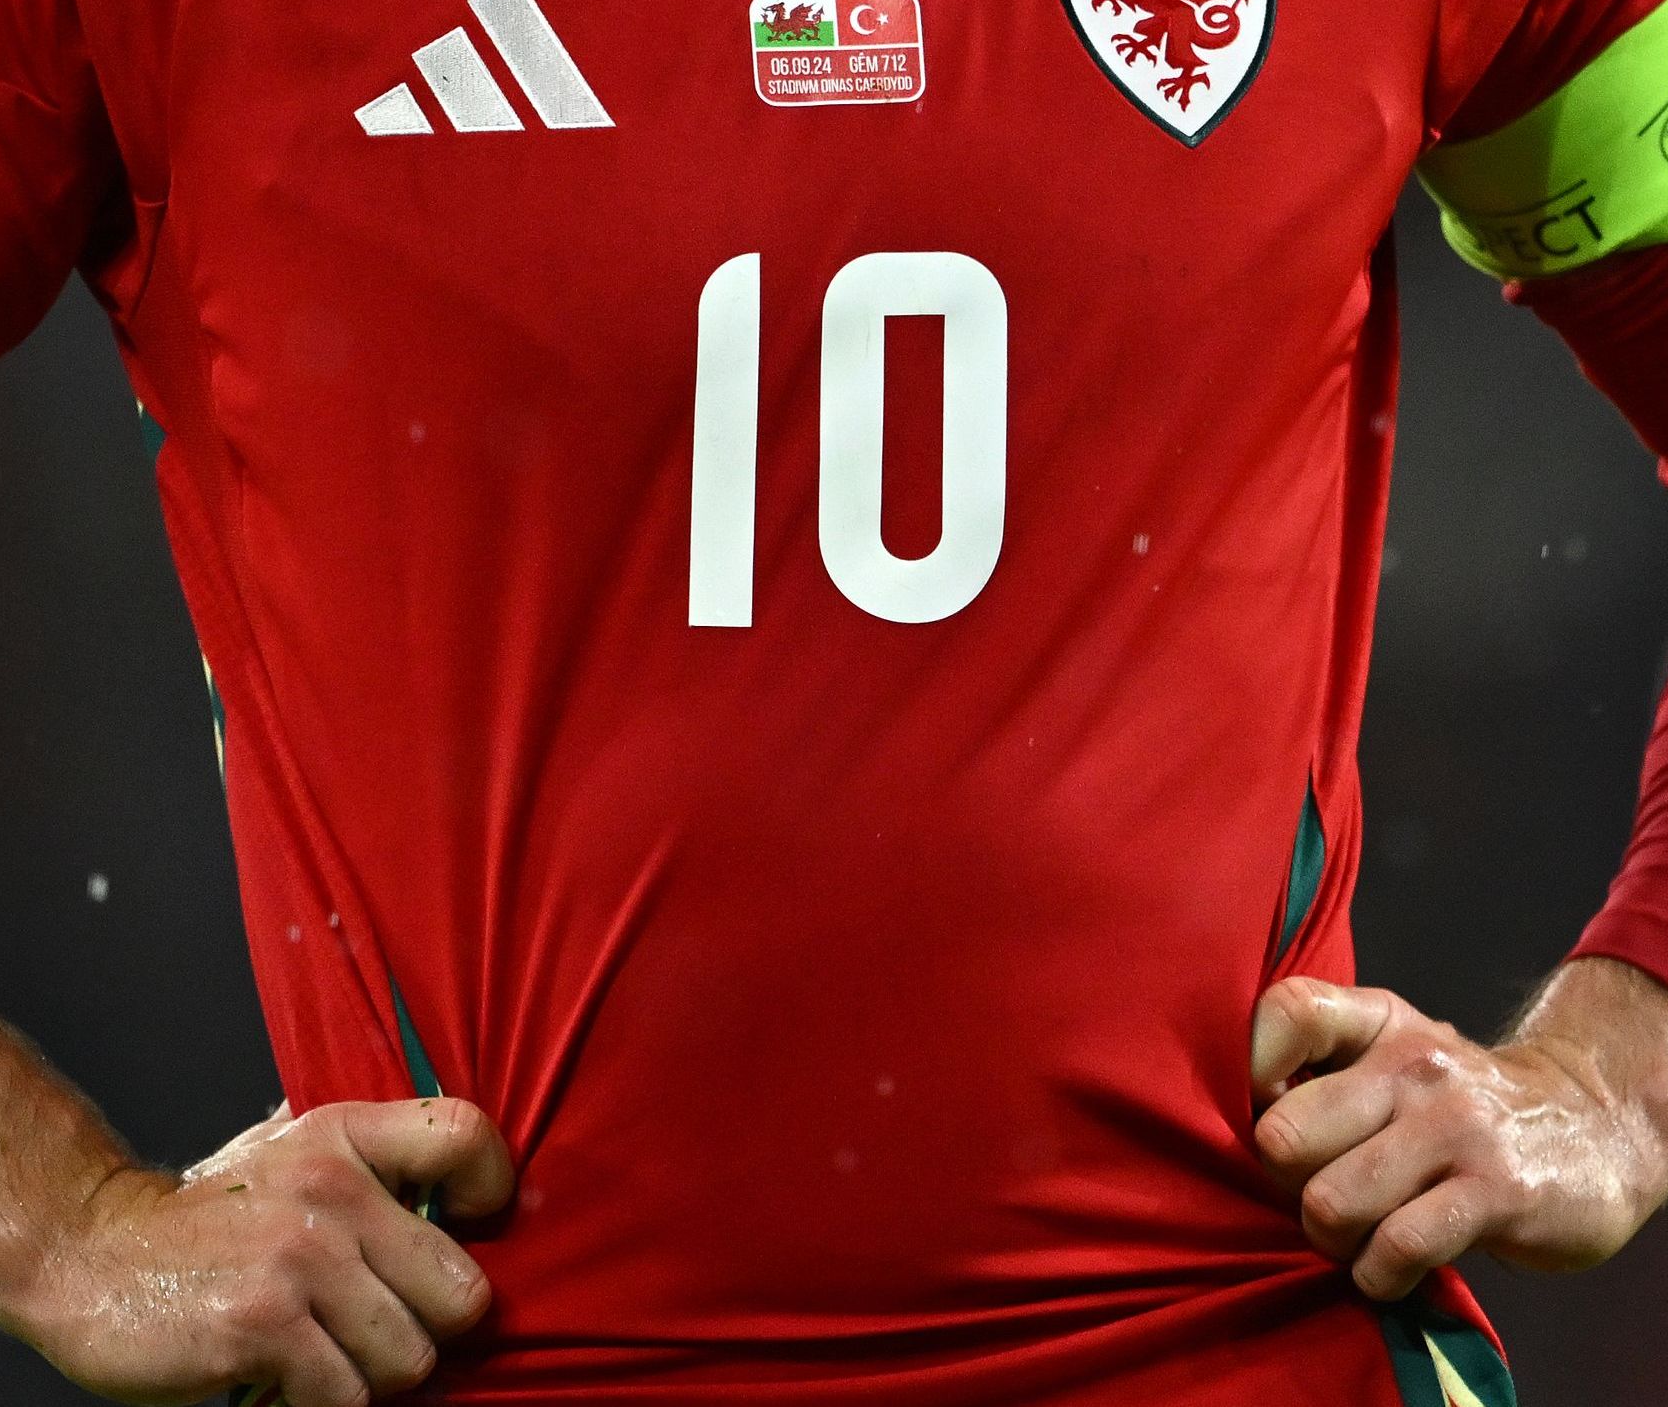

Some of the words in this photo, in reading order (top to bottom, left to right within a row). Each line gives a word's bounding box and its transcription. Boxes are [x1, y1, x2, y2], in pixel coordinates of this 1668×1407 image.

[770, 56, 832, 76] 06.09.24
[881, 54, 907, 72] 712
[768, 79, 819, 95] STADIWM
[820, 78, 854, 93] DINAS
[688, 251, 1008, 628] 10
